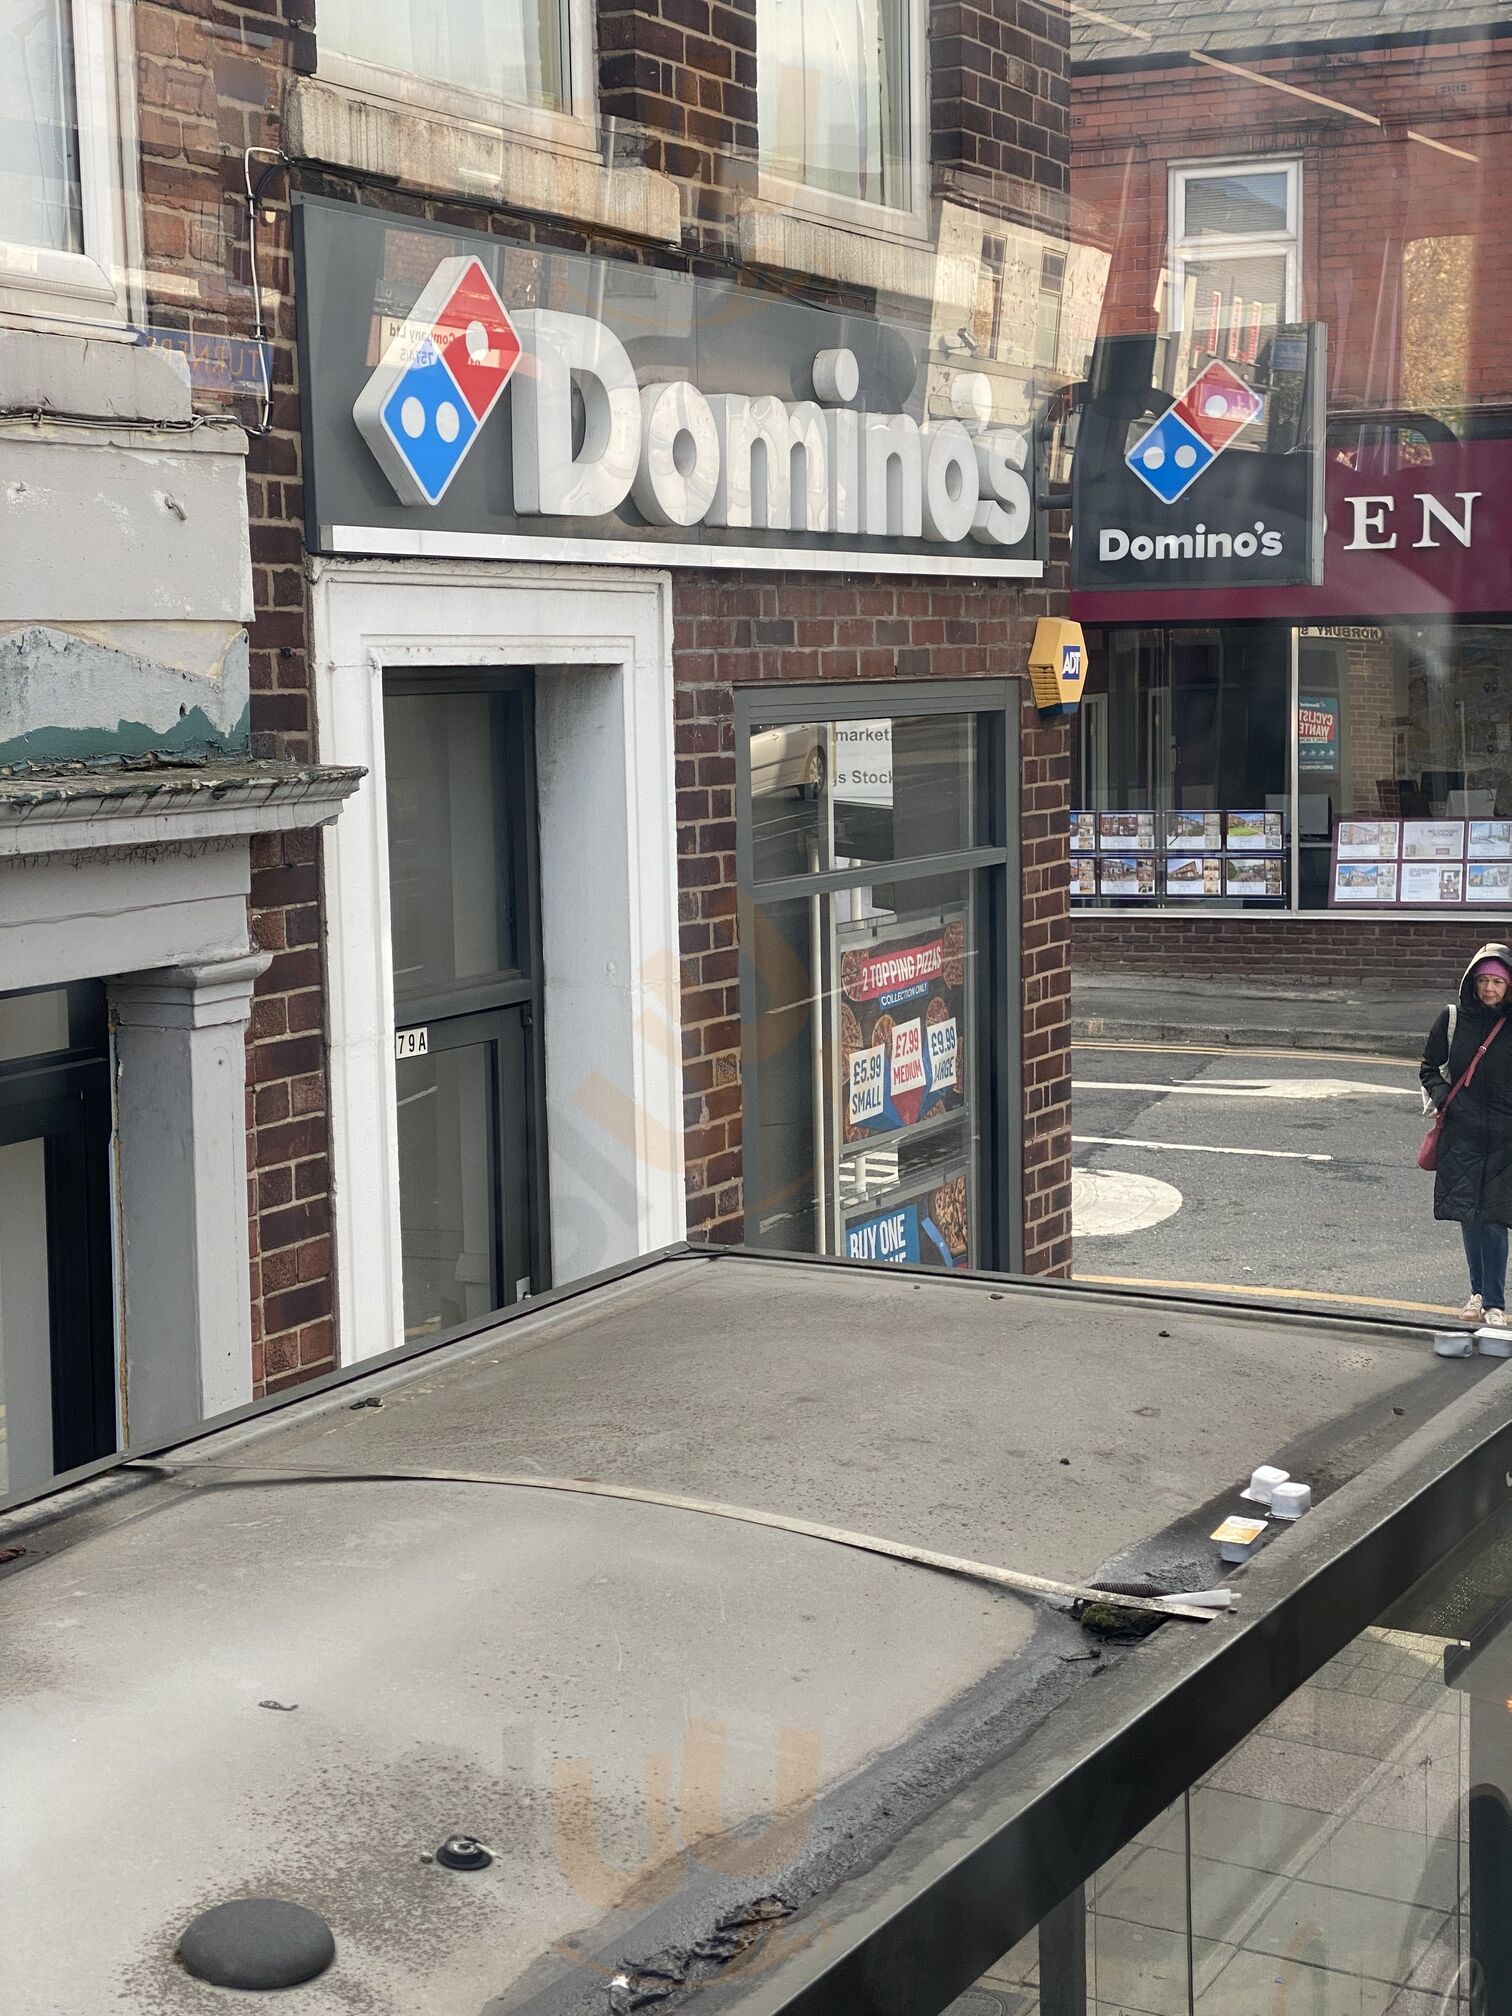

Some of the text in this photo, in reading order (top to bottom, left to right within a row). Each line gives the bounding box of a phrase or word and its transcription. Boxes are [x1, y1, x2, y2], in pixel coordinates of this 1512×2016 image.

[510, 308, 1030, 545] Domino's
[1324, 492, 1483, 550] EN
[1099, 521, 1283, 562] Domino's
[1062, 651, 1081, 674] ADT
[862, 946, 941, 992] 2 TOPPING PIZZAS
[880, 982, 928, 1006] COLLECTION ONLY
[398, 1032, 426, 1054] 79A
[895, 1028, 919, 1058] £7.99
[931, 1025, 956, 1056] £9.99
[853, 1054, 881, 1085] £5.99
[893, 1059, 923, 1086] MEDIUM
[933, 1056, 955, 1083] LARGE
[852, 1086, 881, 1115] SMALL
[850, 1213, 905, 1259] BUY ONE
